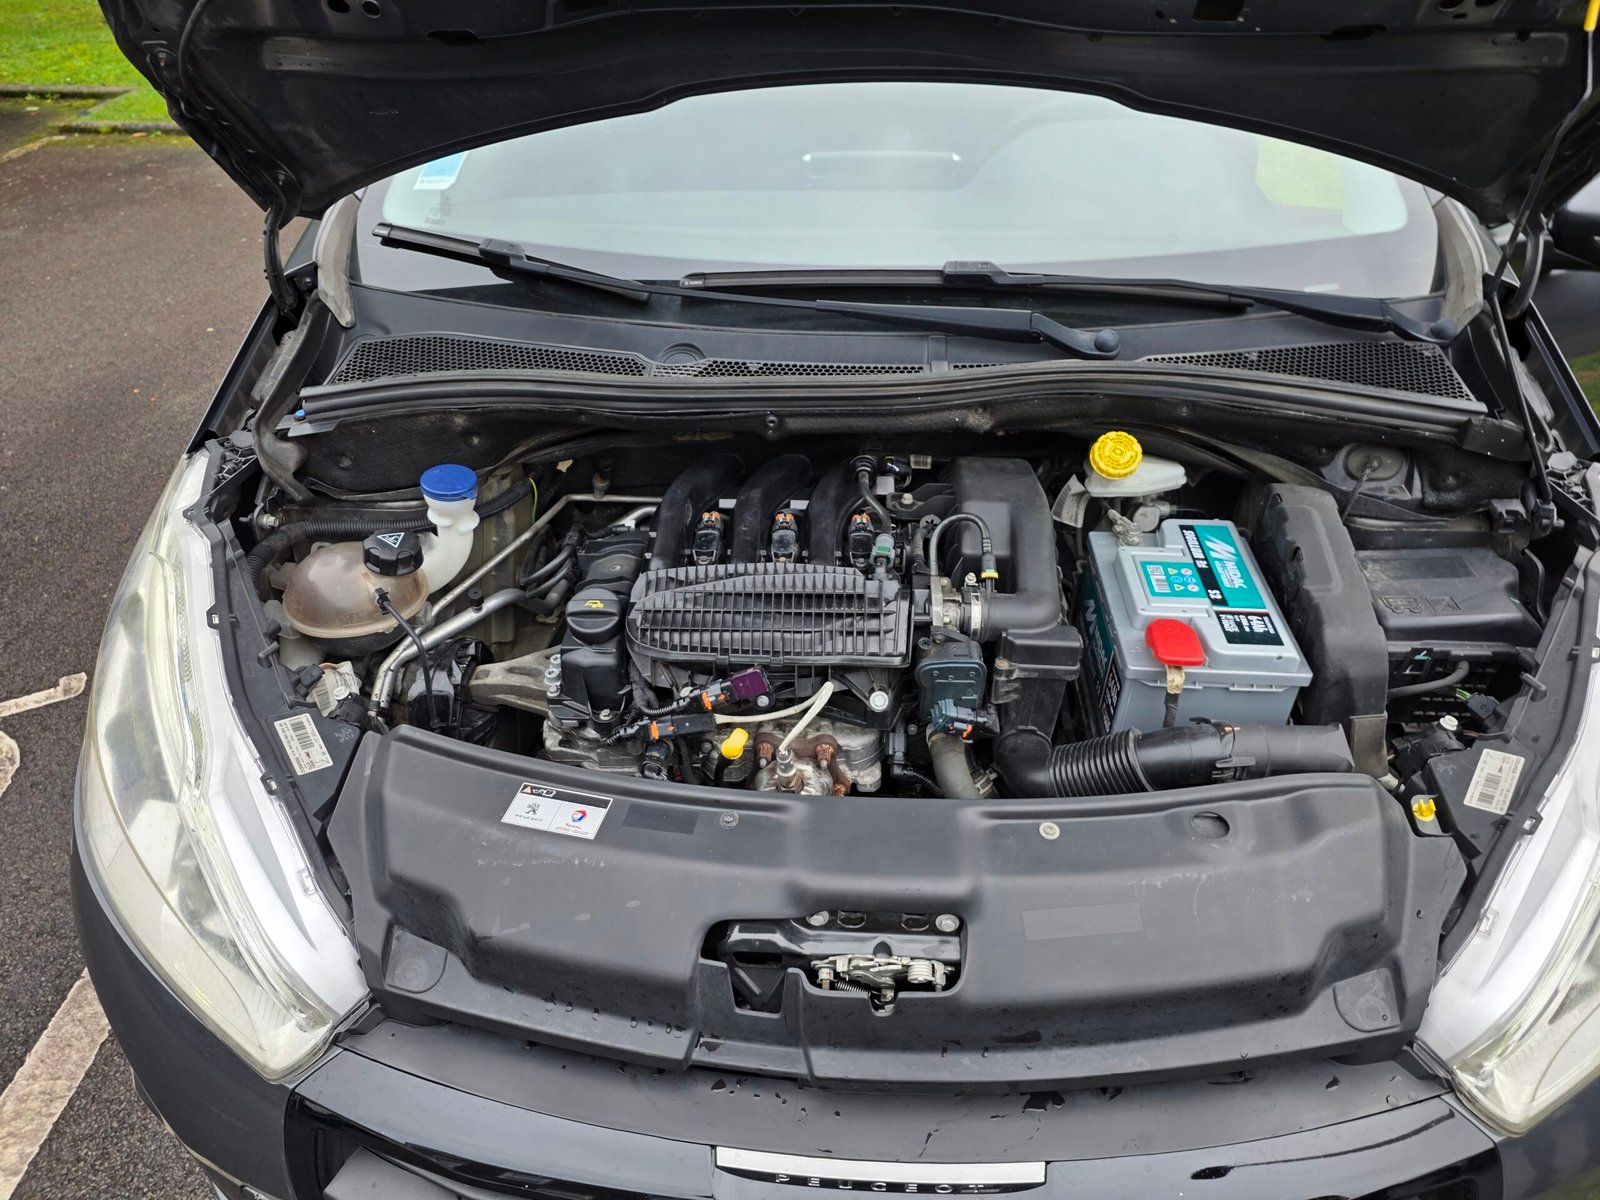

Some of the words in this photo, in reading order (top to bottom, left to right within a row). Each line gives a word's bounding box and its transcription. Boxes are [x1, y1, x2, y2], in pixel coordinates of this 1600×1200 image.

[1223, 560, 1247, 588] MIDAC
[514, 814, 543, 822] PEUGEOT
[776, 1173, 984, 1193] PEUGEOT
